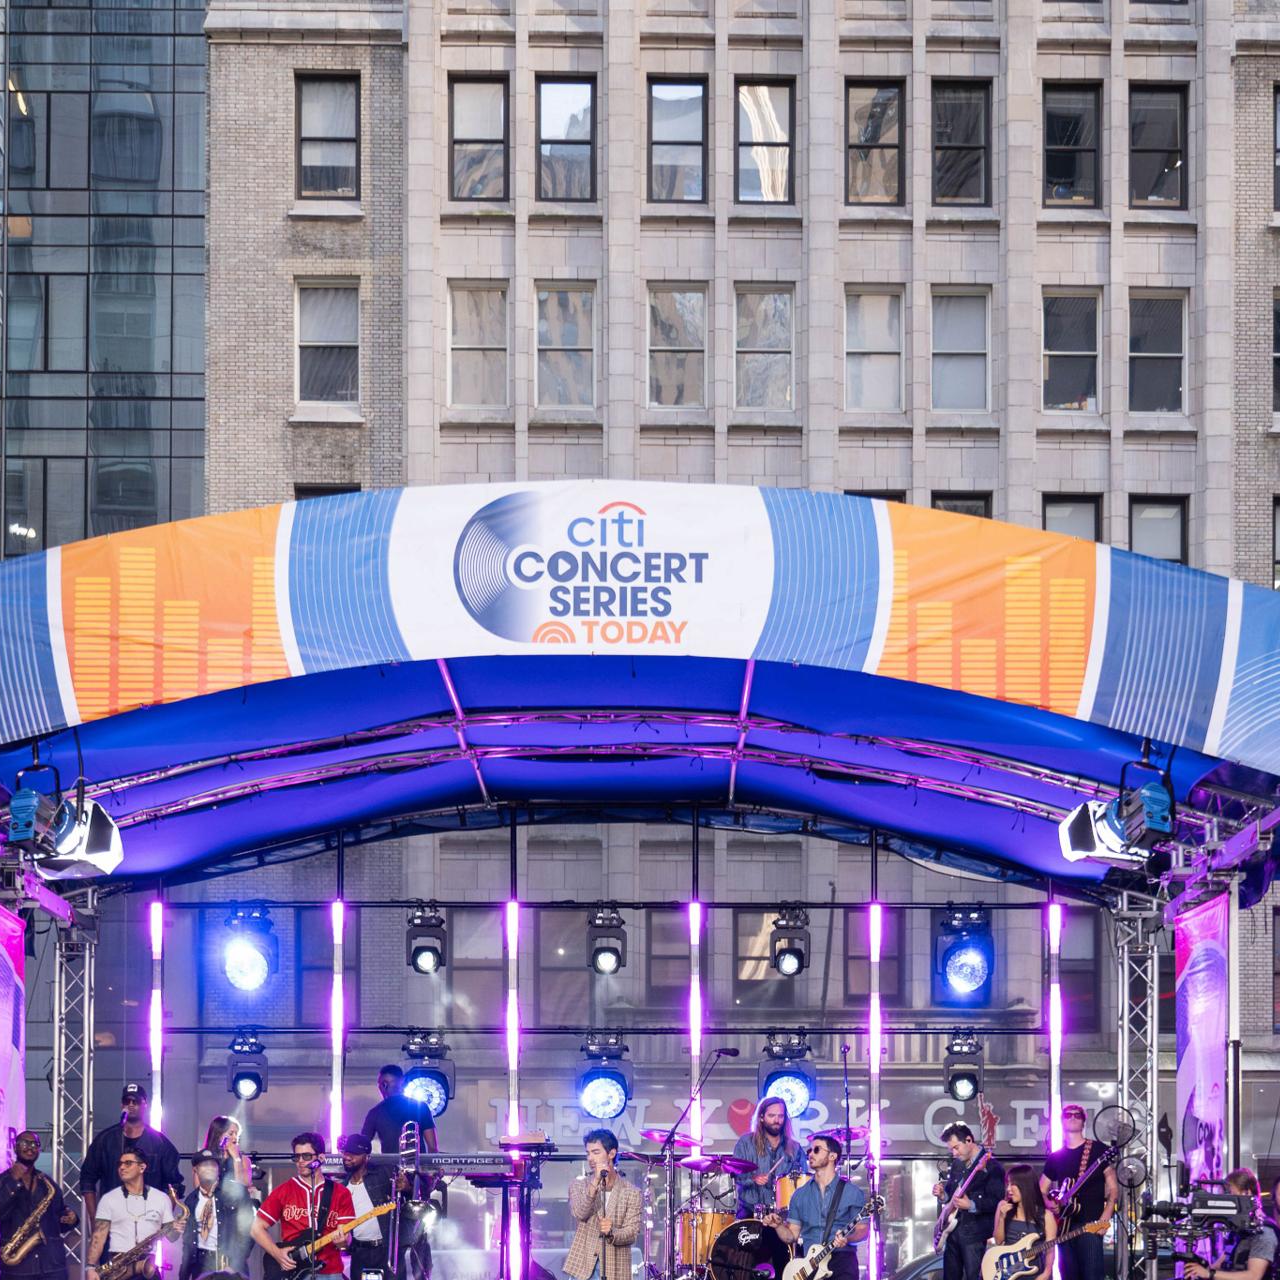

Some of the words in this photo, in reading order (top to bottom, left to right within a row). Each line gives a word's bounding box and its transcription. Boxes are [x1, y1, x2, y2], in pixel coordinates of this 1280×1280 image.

[567, 509, 645, 547] citi
[513, 551, 709, 583] CONCERT
[549, 585, 672, 617] SERIES
[581, 620, 688, 644] TODAY
[325, 1157, 343, 1165] YAMA
